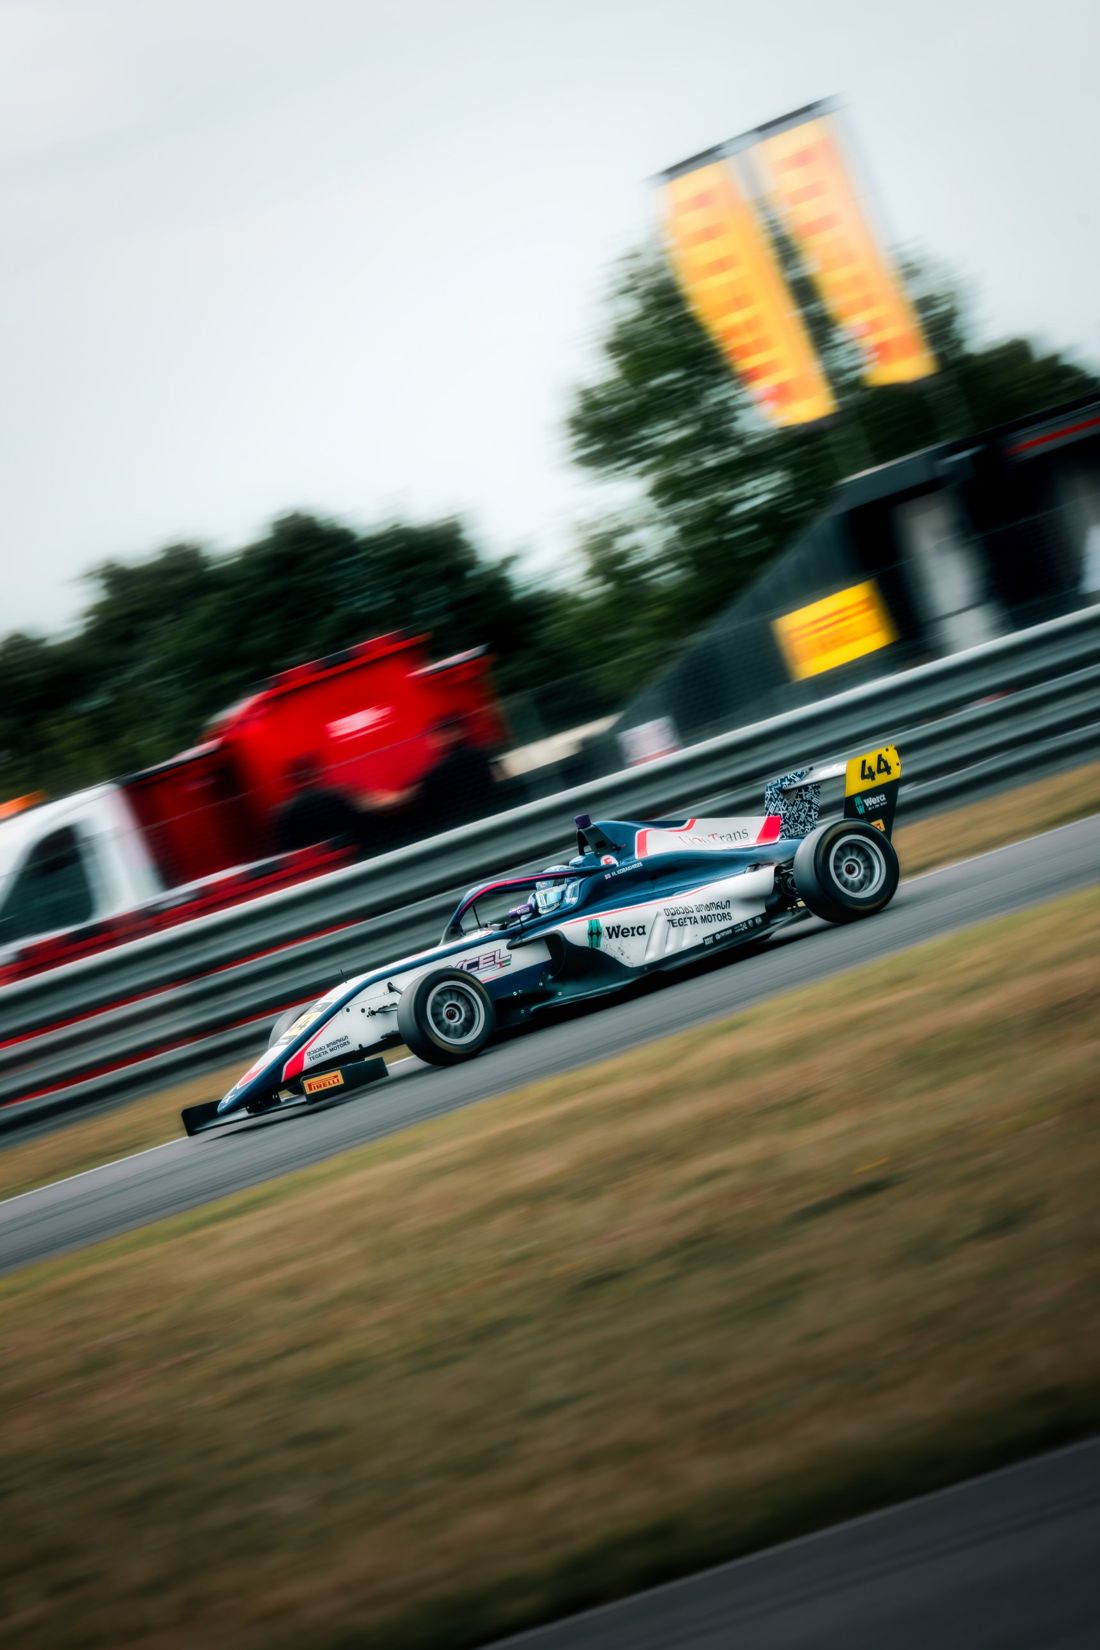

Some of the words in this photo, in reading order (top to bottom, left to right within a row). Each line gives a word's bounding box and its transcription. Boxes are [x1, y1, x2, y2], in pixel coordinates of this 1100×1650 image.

[860, 753, 892, 781] 44
[863, 794, 887, 807] Wera
[667, 916, 699, 928] TEGETA
[700, 912, 733, 924] MOTORS
[605, 924, 647, 940] Wera
[308, 1050, 329, 1062] TEGETA
[329, 1040, 351, 1053] MOTORS
[307, 1074, 340, 1092] PIRELLI
